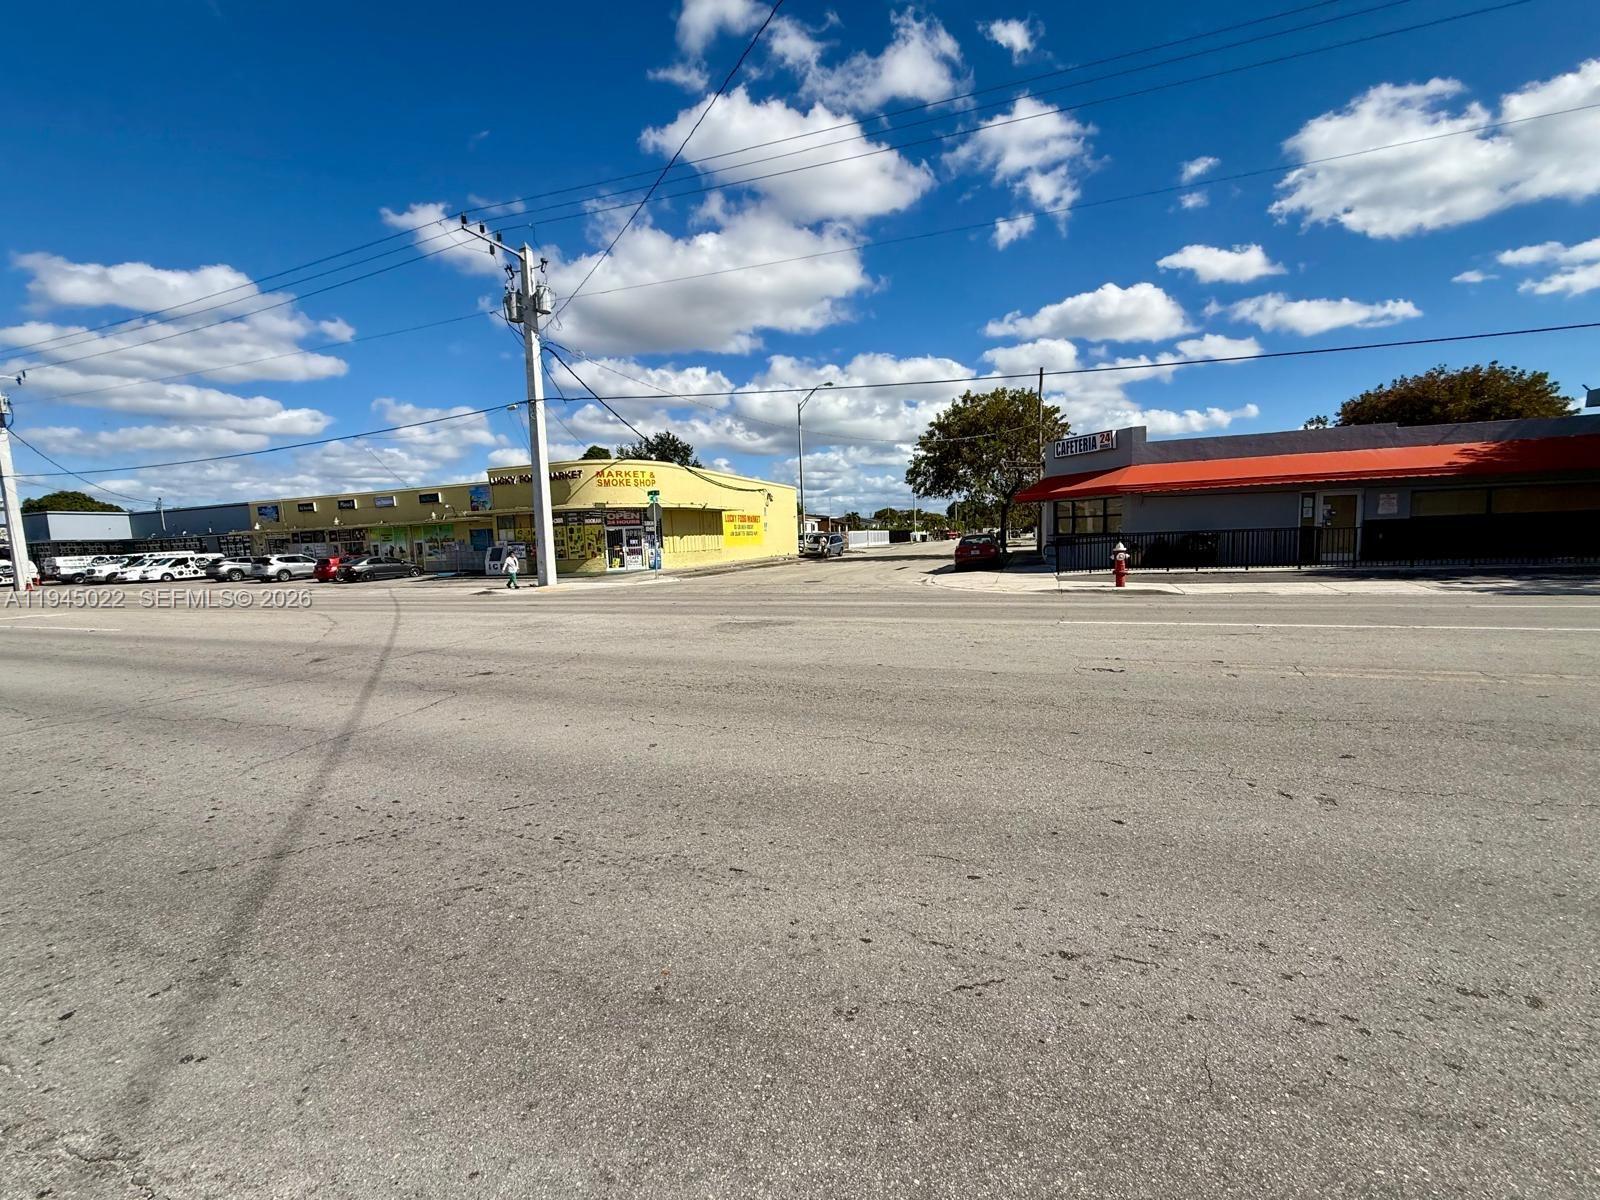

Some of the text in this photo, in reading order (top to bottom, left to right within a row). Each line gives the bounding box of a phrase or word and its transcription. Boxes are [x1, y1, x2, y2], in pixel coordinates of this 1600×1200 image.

[1100, 433, 1110, 443] 24
[1056, 436, 1097, 456] CAFETERIA
[596, 470, 646, 478] MARKET
[490, 475, 517, 486] LUCKY
[520, 474, 533, 484] FO
[597, 479, 656, 487] SMOKE SHOP
[607, 512, 640, 520] OPEN
[725, 514, 736, 523] LUCKY
